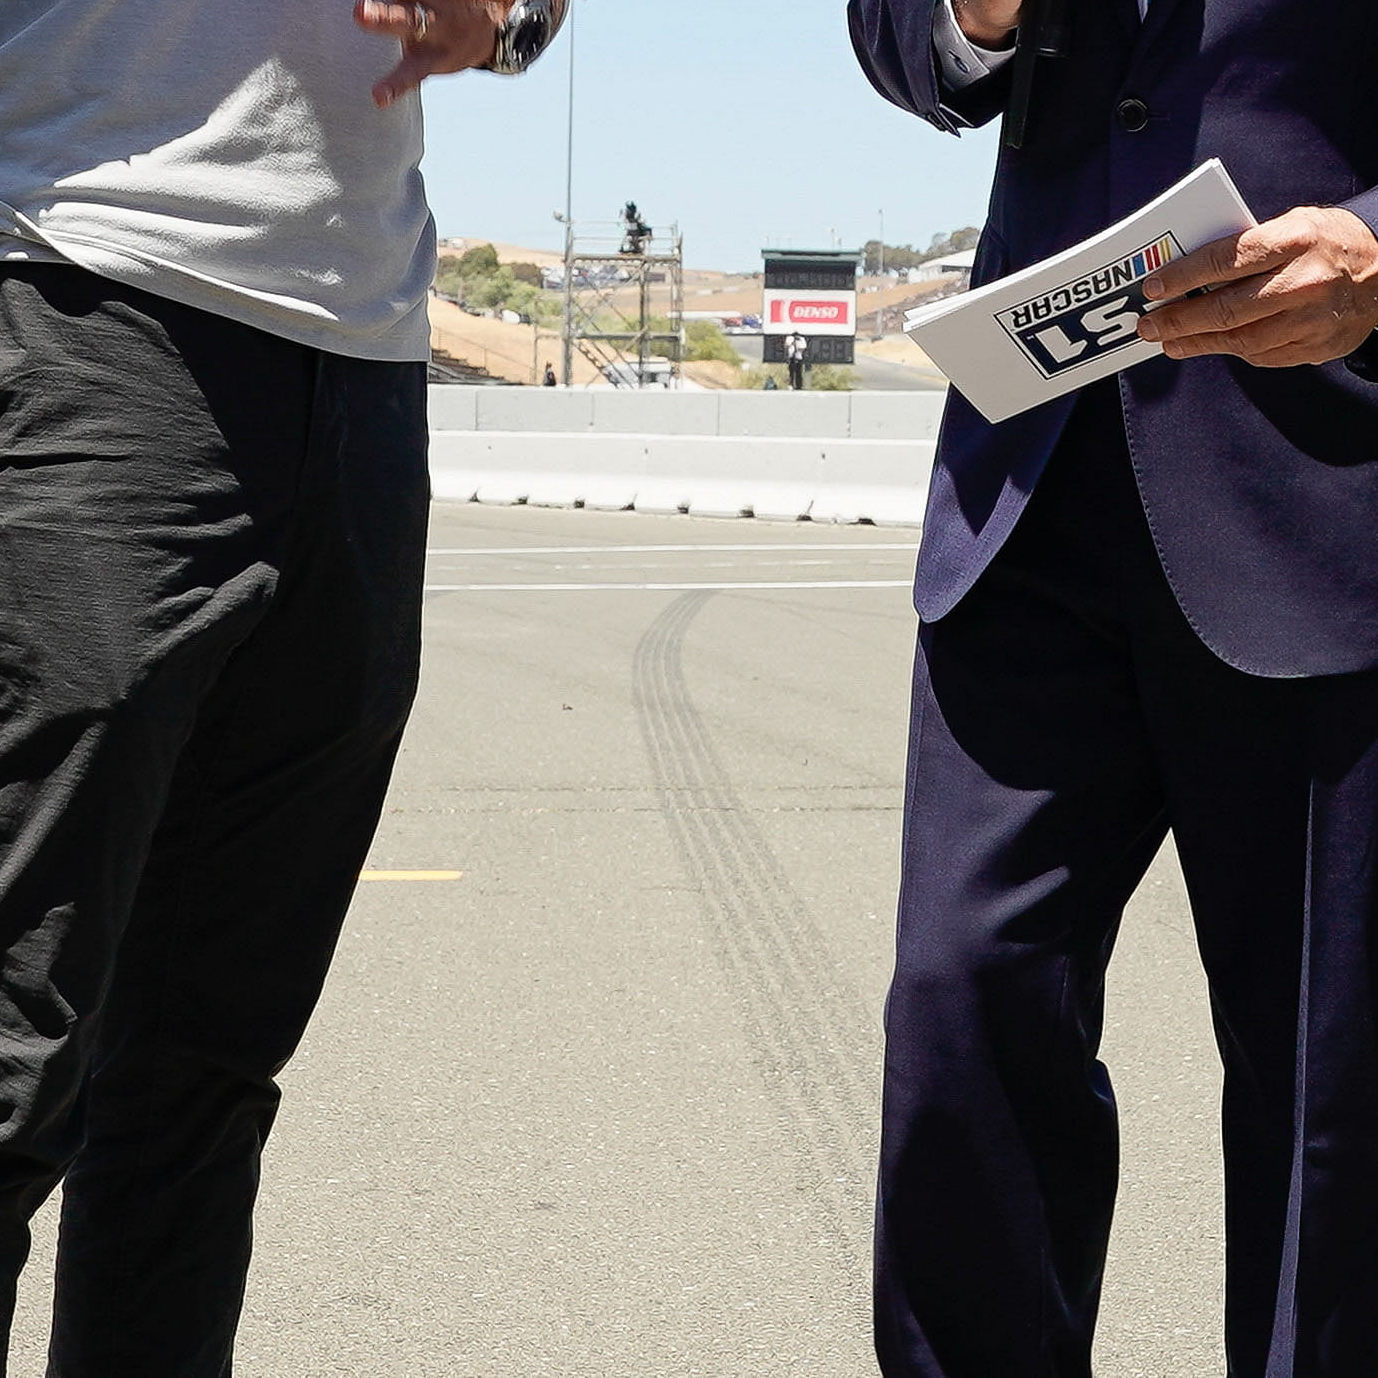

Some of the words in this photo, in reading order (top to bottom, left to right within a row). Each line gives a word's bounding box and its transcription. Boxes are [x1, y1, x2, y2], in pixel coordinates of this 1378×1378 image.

[793, 306, 839, 319] DENSO
[1011, 259, 1135, 329] NASCAR
[1036, 294, 1157, 364] S1
